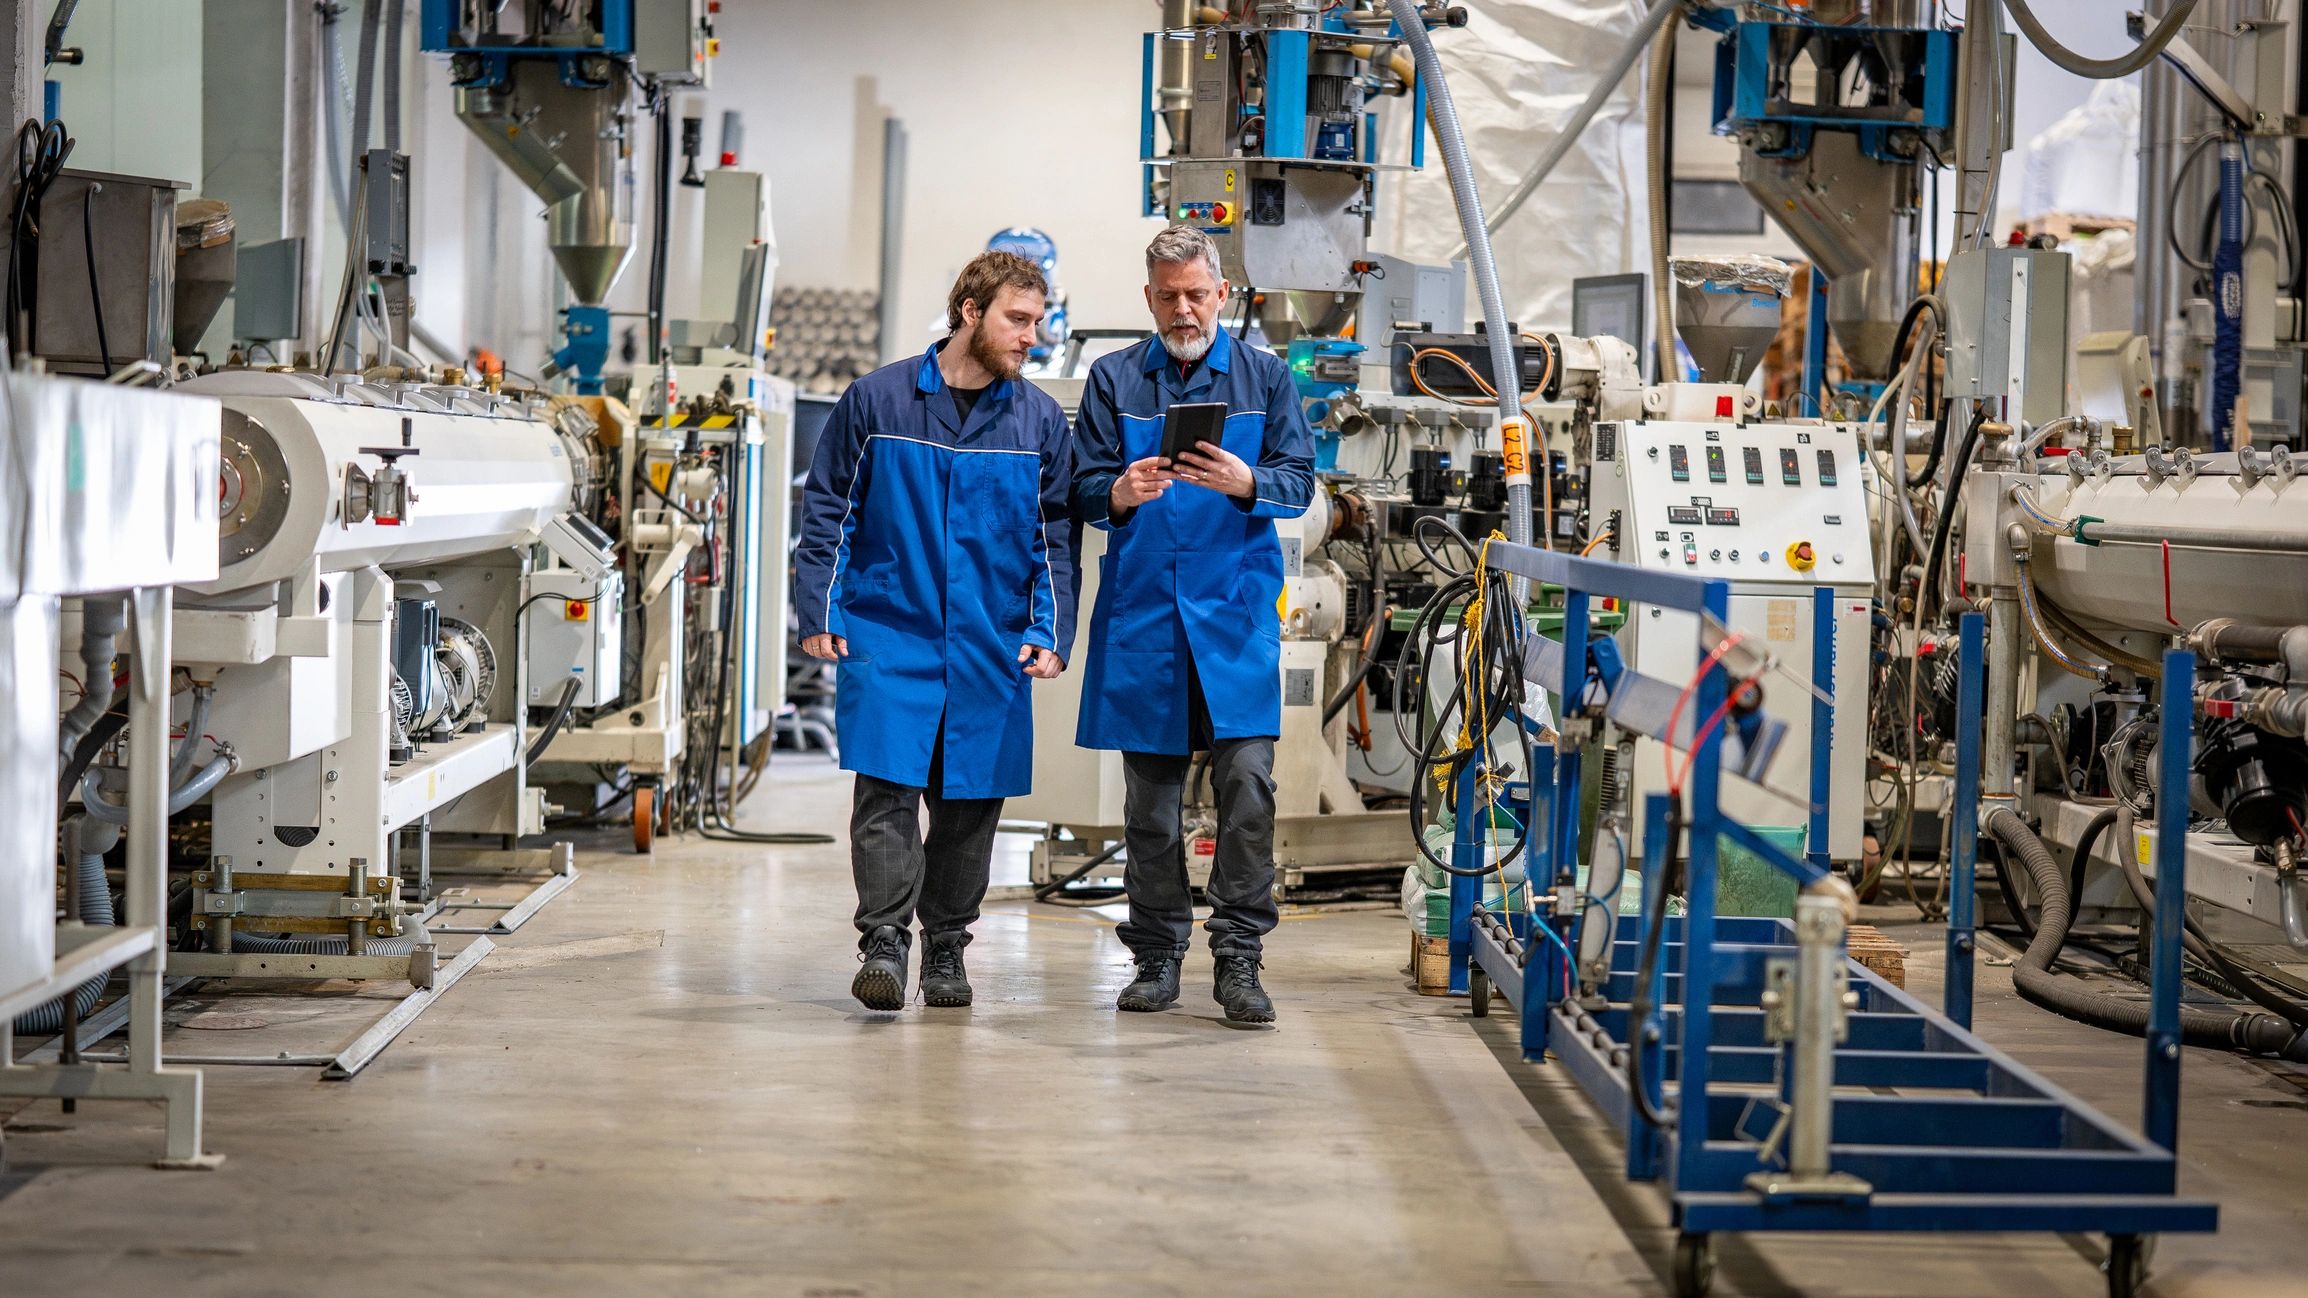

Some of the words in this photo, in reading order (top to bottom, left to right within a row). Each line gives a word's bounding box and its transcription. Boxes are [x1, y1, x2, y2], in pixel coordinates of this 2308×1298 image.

[1226, 173, 1233, 187] C
[1503, 426, 1521, 446] L2
[1506, 452, 1524, 473] C2
